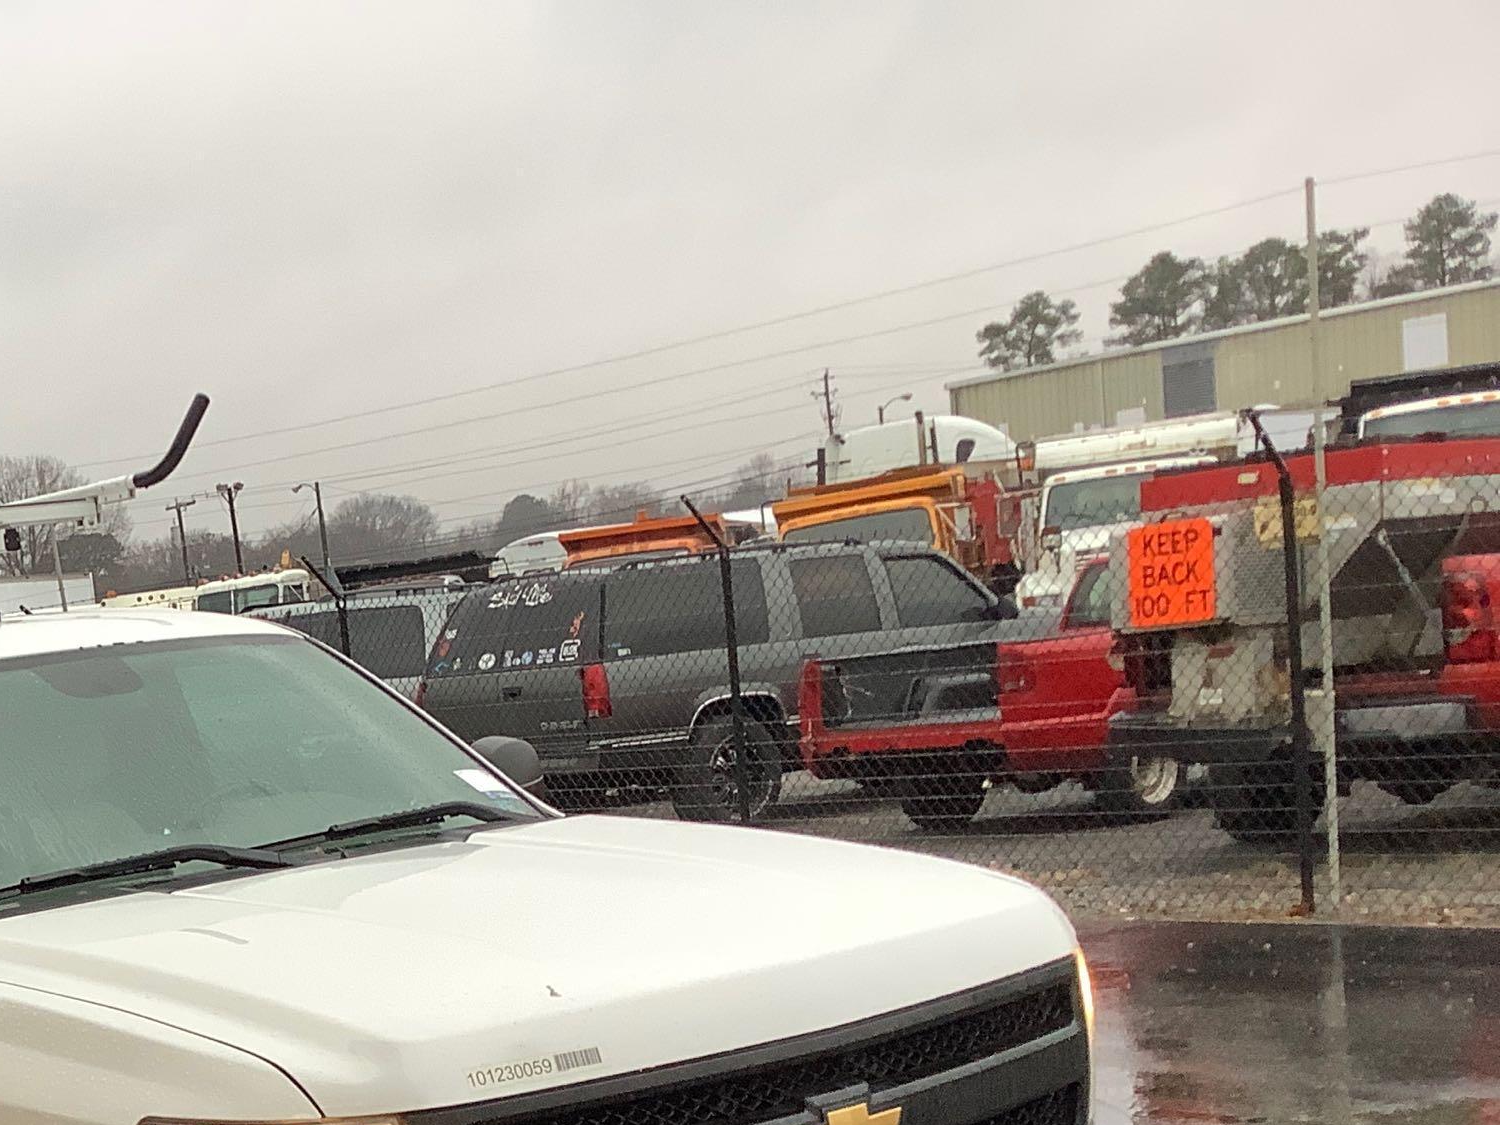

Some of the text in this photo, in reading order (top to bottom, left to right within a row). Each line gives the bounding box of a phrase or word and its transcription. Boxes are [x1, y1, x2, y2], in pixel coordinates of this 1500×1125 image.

[1142, 528, 1198, 558] KEEP
[1142, 560, 1200, 589] BACK
[1135, 589, 1211, 619] 100 FT
[467, 1058, 553, 1087] 101230059
